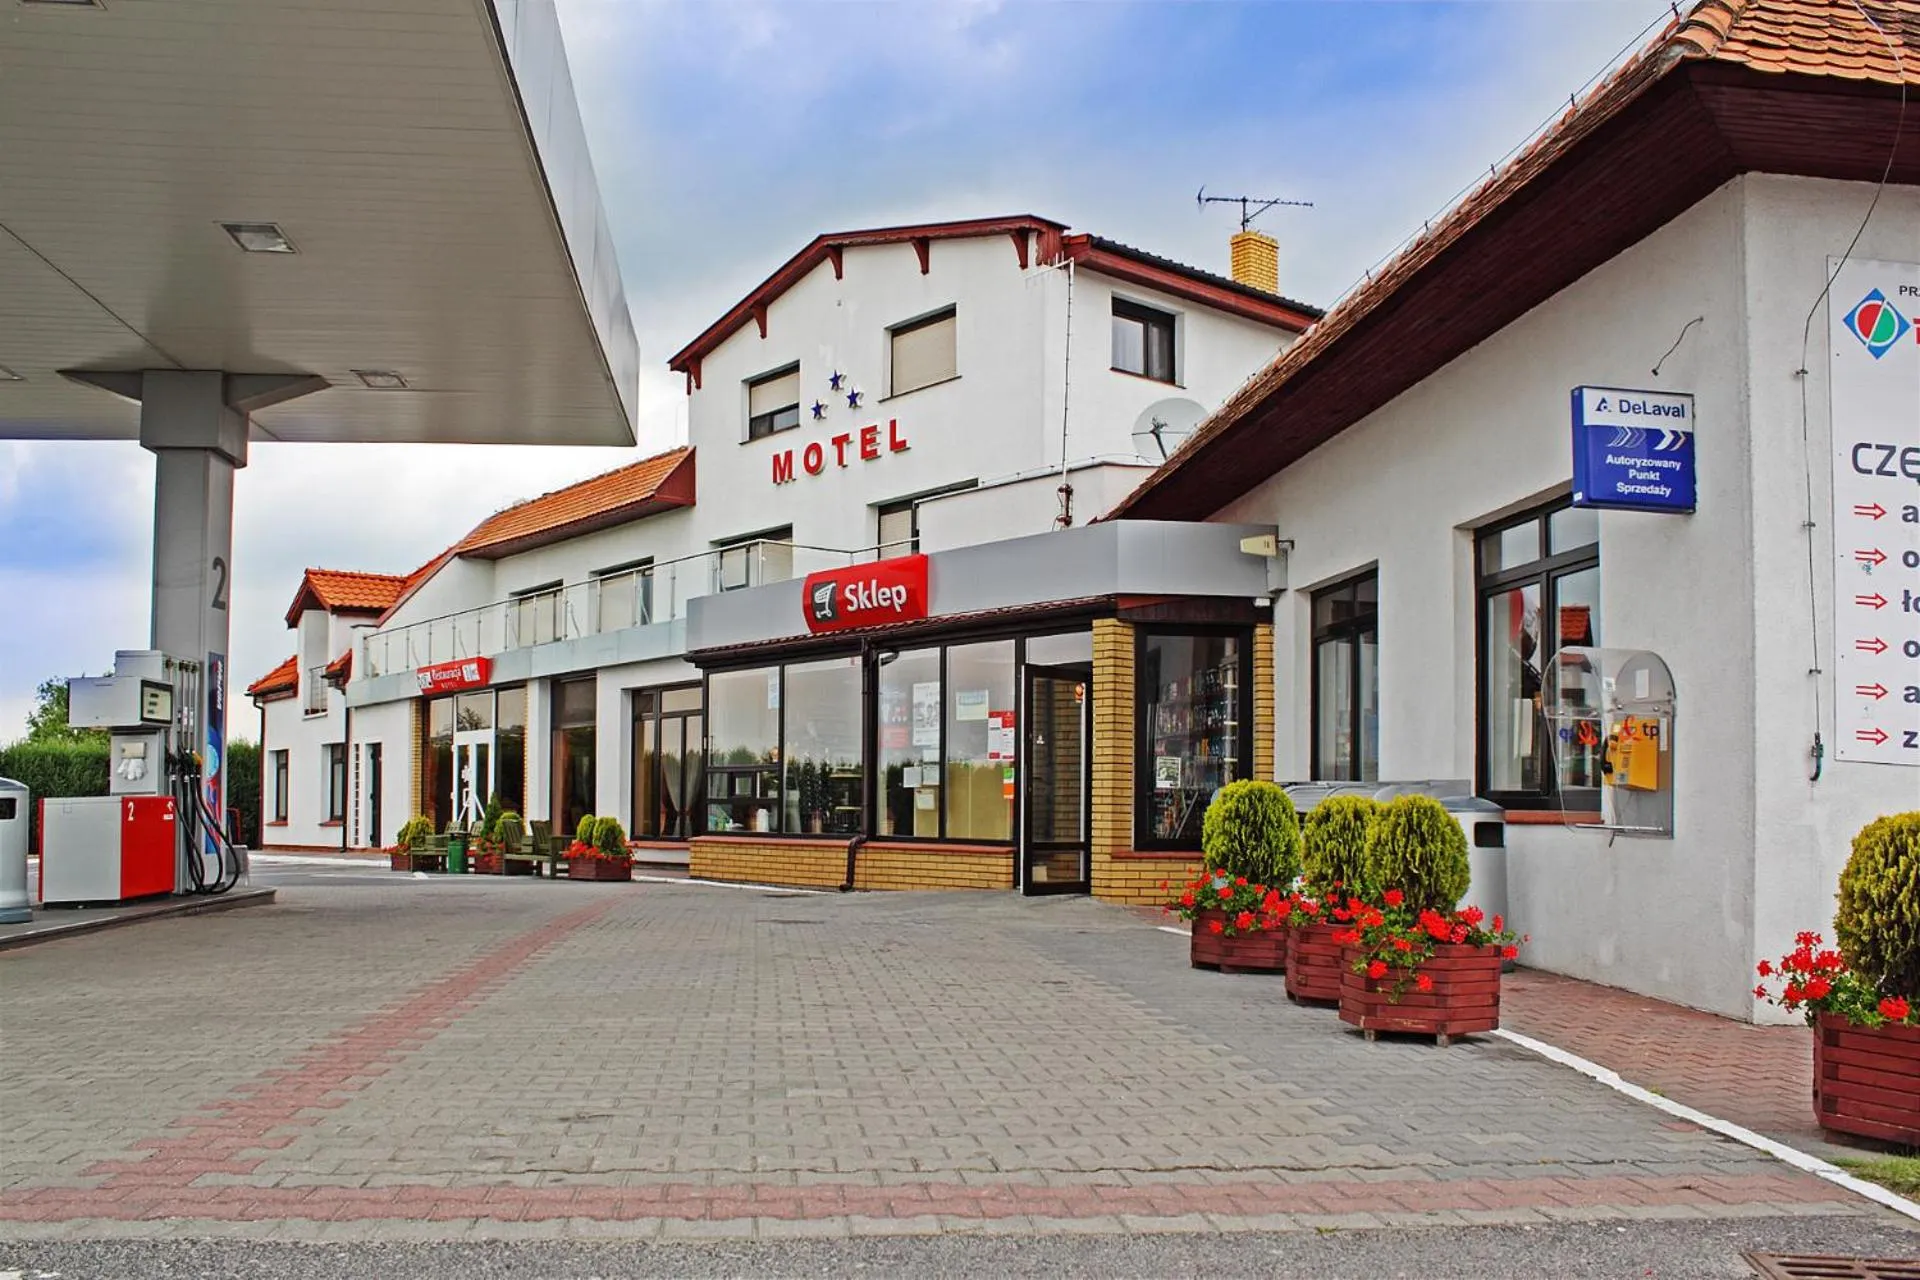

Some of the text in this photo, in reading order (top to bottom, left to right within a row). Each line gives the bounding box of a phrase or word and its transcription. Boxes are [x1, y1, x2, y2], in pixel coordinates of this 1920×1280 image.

[1899, 285, 1920, 297] PR
[1619, 399, 1685, 418] DeLaval
[773, 418, 910, 485] MOTEL
[1605, 454, 1682, 471] Autoryzowany
[1628, 469, 1660, 481] Punkt
[1616, 482, 1672, 497] Sprzedaży
[212, 556, 226, 610] 2
[844, 579, 907, 612] Sklep
[1643, 722, 1660, 740] tp
[127, 801, 135, 822] 2
